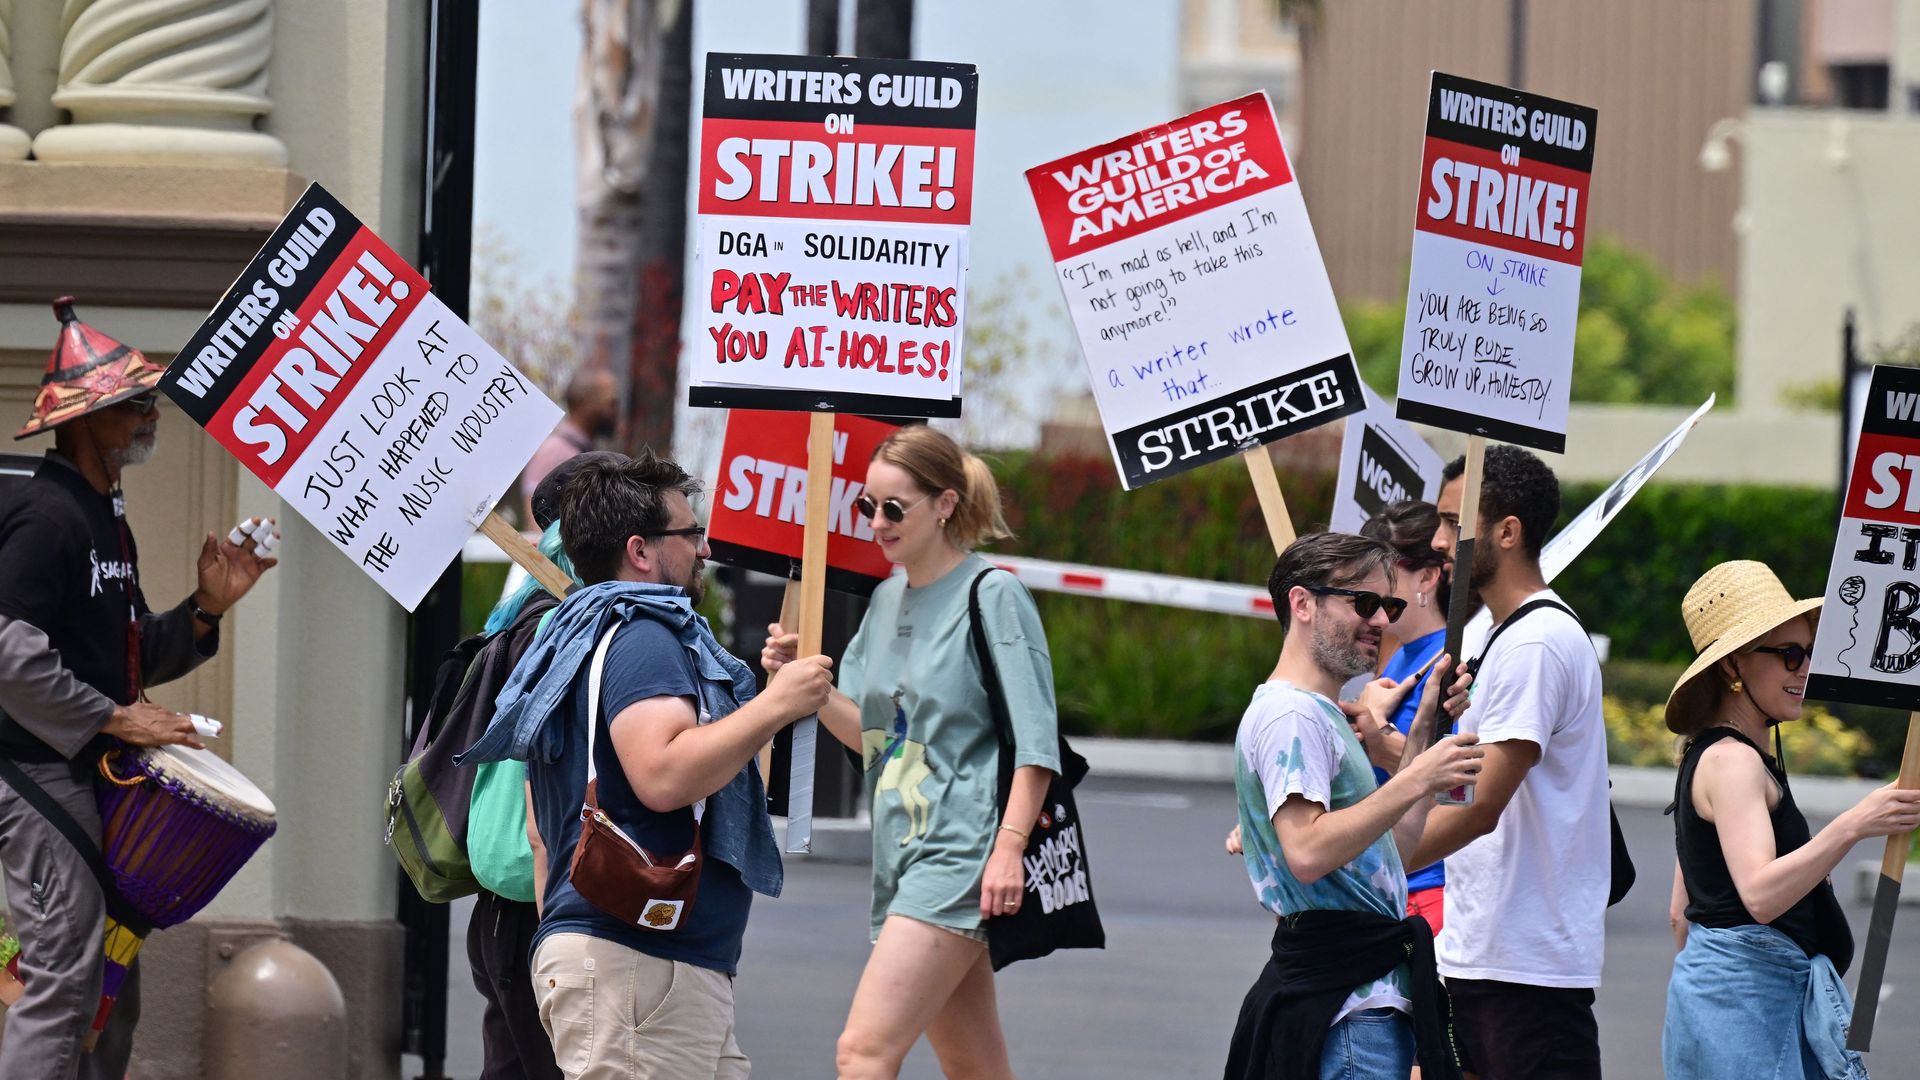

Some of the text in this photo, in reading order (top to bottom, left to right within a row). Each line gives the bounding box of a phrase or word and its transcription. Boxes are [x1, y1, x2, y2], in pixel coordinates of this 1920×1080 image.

[722, 68, 963, 109] WRITERS GUILD
[1440, 88, 1586, 151] WRITERS GUILD
[824, 113, 855, 135] ON
[1052, 109, 1248, 193] WRITERS
[1501, 143, 1520, 167] ON
[715, 137, 957, 211] STRIKE!
[1068, 141, 1246, 215] GUILD OF
[1068, 158, 1270, 246] AMERICA
[1427, 157, 1578, 251] STRIKE!
[718, 231, 950, 268] DGA IN SOLIDARITY
[1121, 249, 1150, 274] mad
[1157, 248, 1172, 264] as
[1178, 230, 1210, 258] hell,
[1213, 222, 1237, 244] and
[1246, 207, 1278, 235] I'm
[1466, 250, 1548, 287] ON STRIKE
[176, 206, 336, 400] WRITERS GUILD
[710, 269, 957, 327] PAY THE WRITERS
[1090, 242, 1263, 313] not going to take this
[1418, 288, 1449, 324] YOU
[1457, 295, 1481, 324] ARE
[1529, 312, 1548, 332] SO
[272, 308, 300, 340] ON
[709, 322, 951, 382] YOU AI-HOLES!
[1108, 308, 1297, 387] a writer wrote
[1420, 330, 1468, 354] TRULY
[232, 249, 411, 468] STRIKE!
[1411, 353, 1458, 389] GROW
[304, 320, 450, 510] JUST LOOK AT
[806, 430, 849, 465] N
[1138, 369, 1345, 474] STRIKE
[329, 353, 479, 546] WHAT HAPPENED TO
[364, 364, 528, 574] THE MUSIC INDUSTRY
